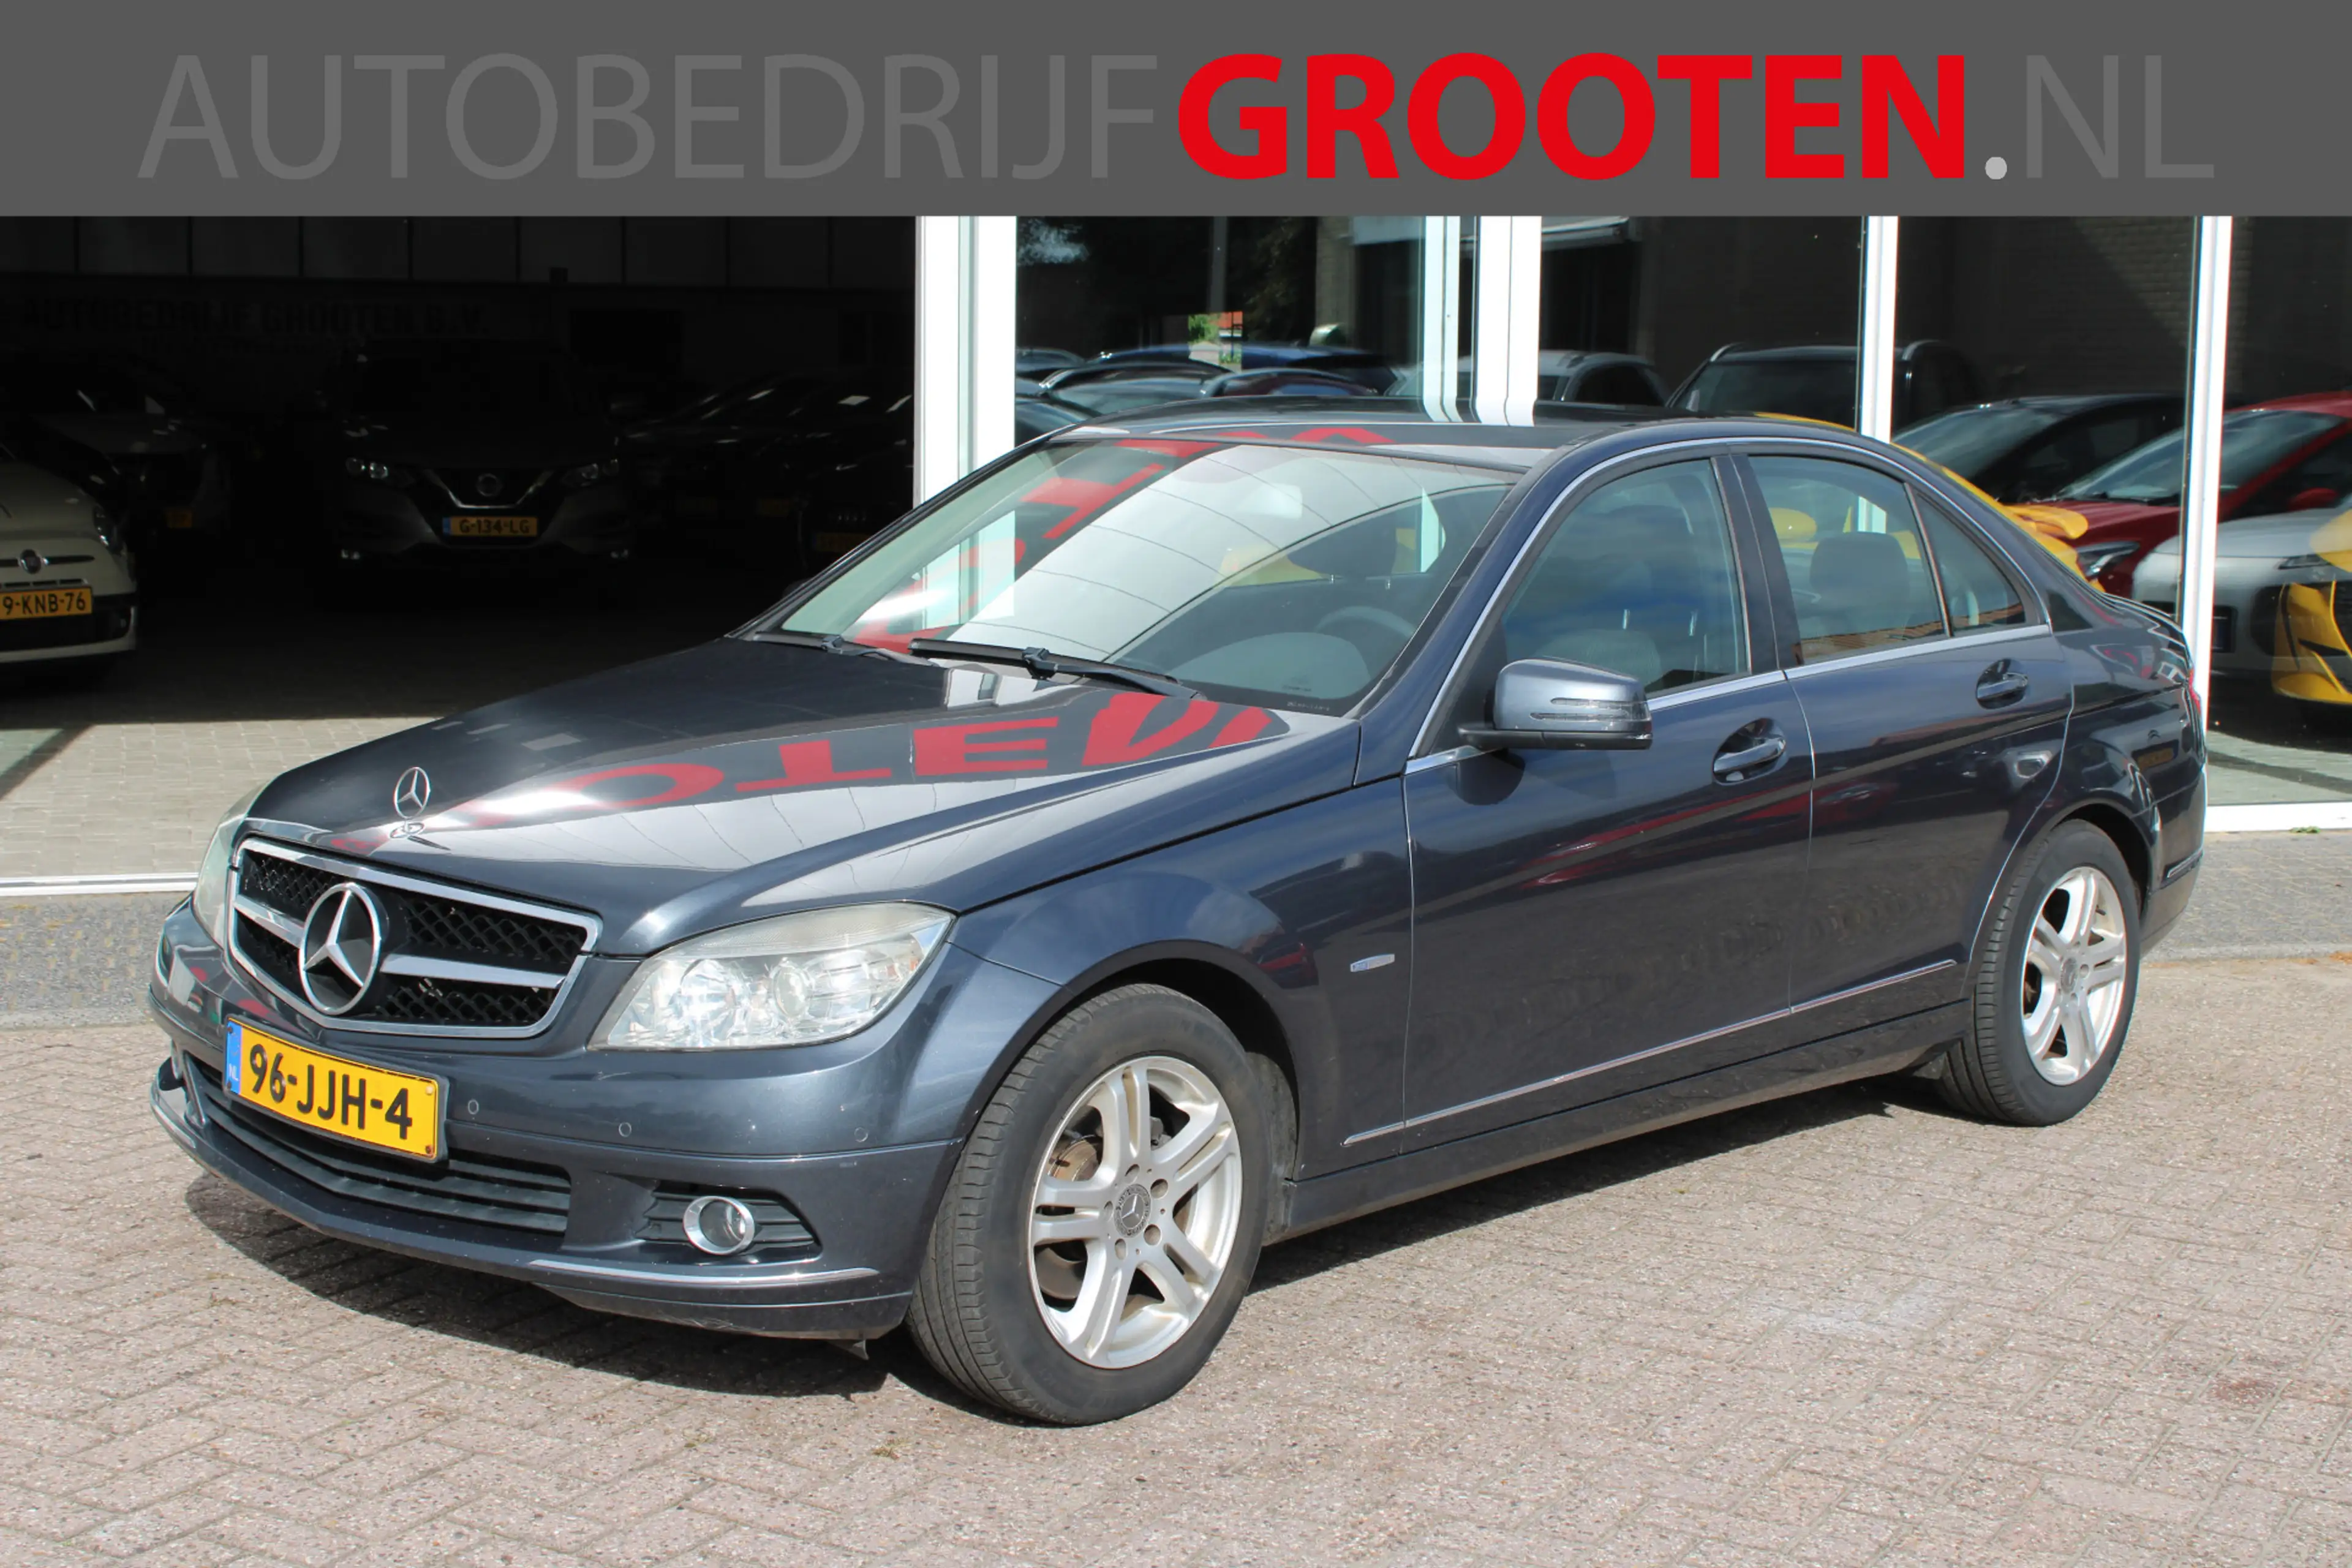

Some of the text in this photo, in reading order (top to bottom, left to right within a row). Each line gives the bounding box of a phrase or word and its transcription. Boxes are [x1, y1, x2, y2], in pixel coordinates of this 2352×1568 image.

[461, 519, 530, 534] G-134-LG
[2, 592, 86, 616] 9-KNB-76
[228, 1062, 239, 1082] NL
[249, 1043, 413, 1140] 96-JJH-4
